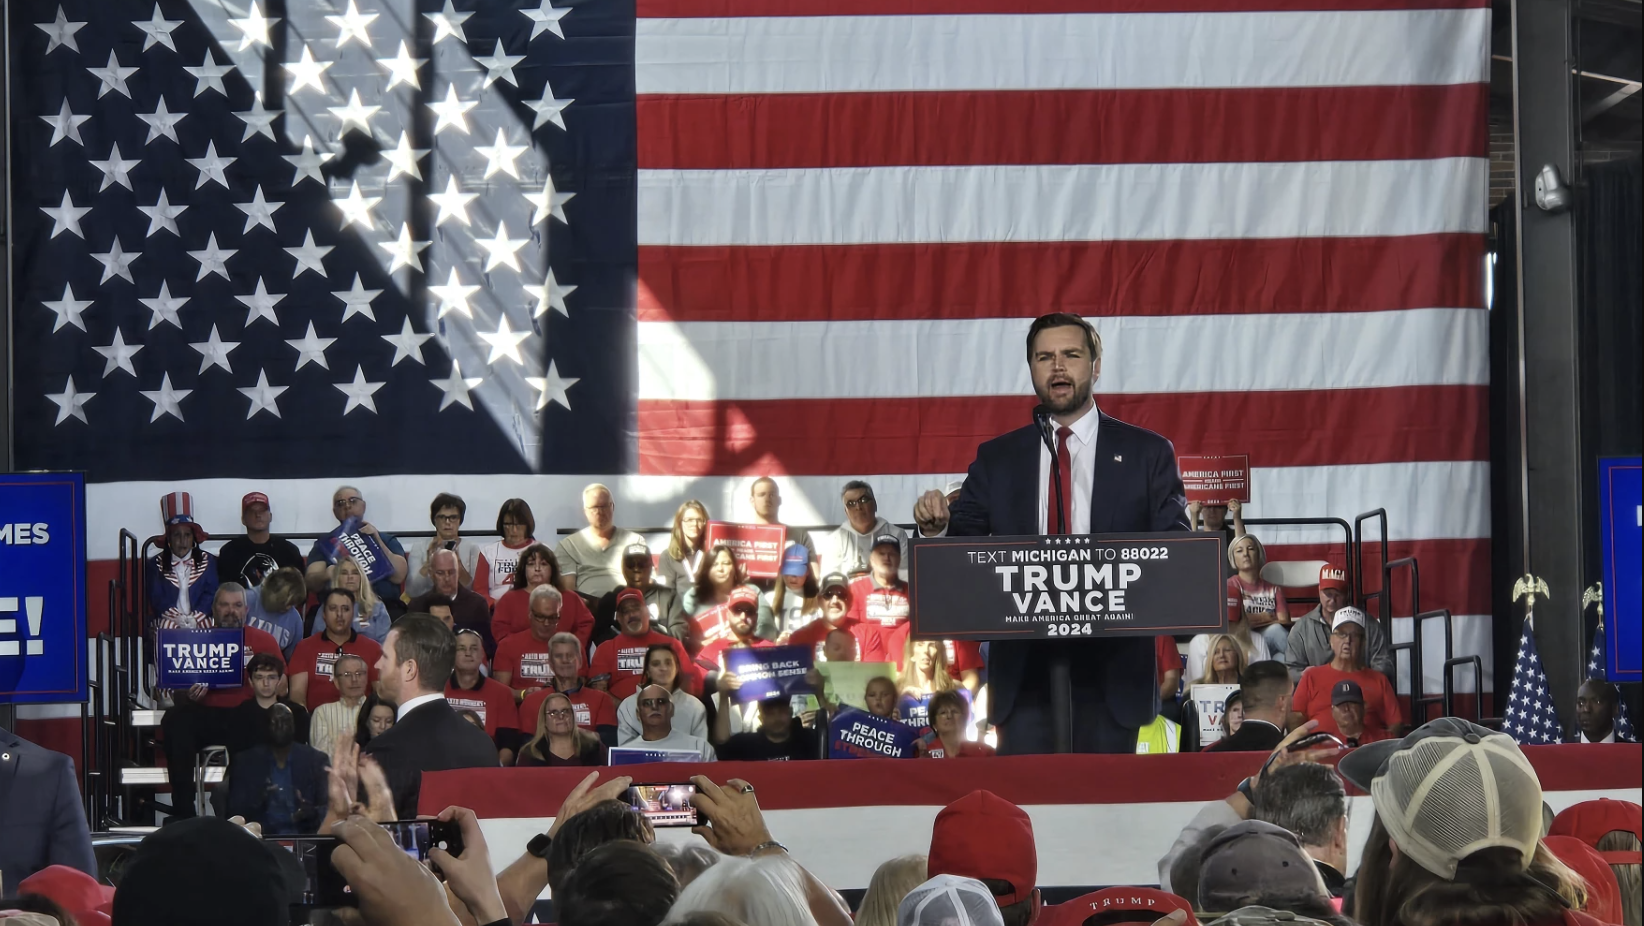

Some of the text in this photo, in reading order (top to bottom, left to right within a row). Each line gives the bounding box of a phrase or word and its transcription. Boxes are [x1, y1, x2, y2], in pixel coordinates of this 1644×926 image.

[350, 533, 376, 563] PEACE
[967, 547, 1169, 564] TEXT MICHIGAN TO 88022
[995, 563, 1142, 592] TRUMP
[1012, 590, 1126, 614] VANCE
[1005, 615, 1030, 623] MAKE
[1032, 614, 1071, 622] AMERICA
[1047, 622, 1092, 636] 2024
[163, 643, 240, 658] TRUMP
[172, 657, 231, 669] VANCE
[772, 660, 800, 669] BACK
[777, 667, 808, 678] SENSE
[852, 722, 895, 744] PEACE
[840, 729, 902, 757] THROUGH
[1089, 897, 1155, 910] TRUMP
